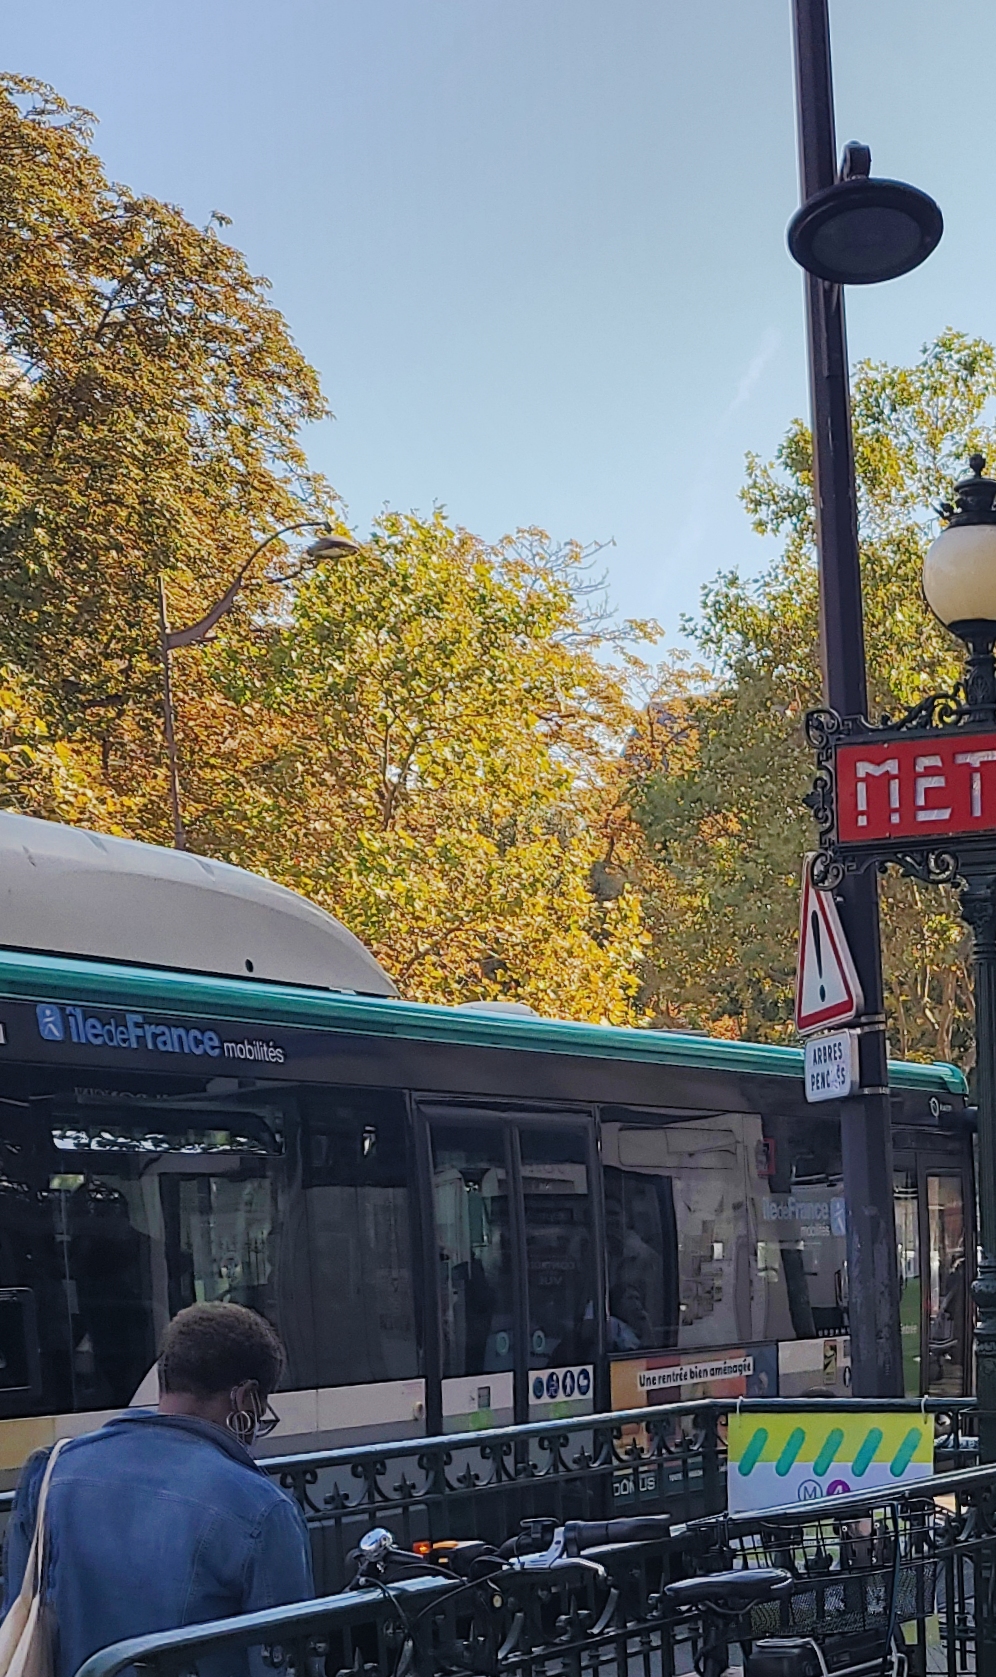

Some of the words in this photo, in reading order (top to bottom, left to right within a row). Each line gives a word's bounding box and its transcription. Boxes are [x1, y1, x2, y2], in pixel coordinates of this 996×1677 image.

[223, 1039, 284, 1063] mobilités
[813, 1042, 843, 1066] ARBRES
[811, 1064, 846, 1091] PENCÉS
[639, 1374, 656, 1387] Une
[658, 1368, 688, 1384] rentrée
[689, 1365, 708, 1379] bien
